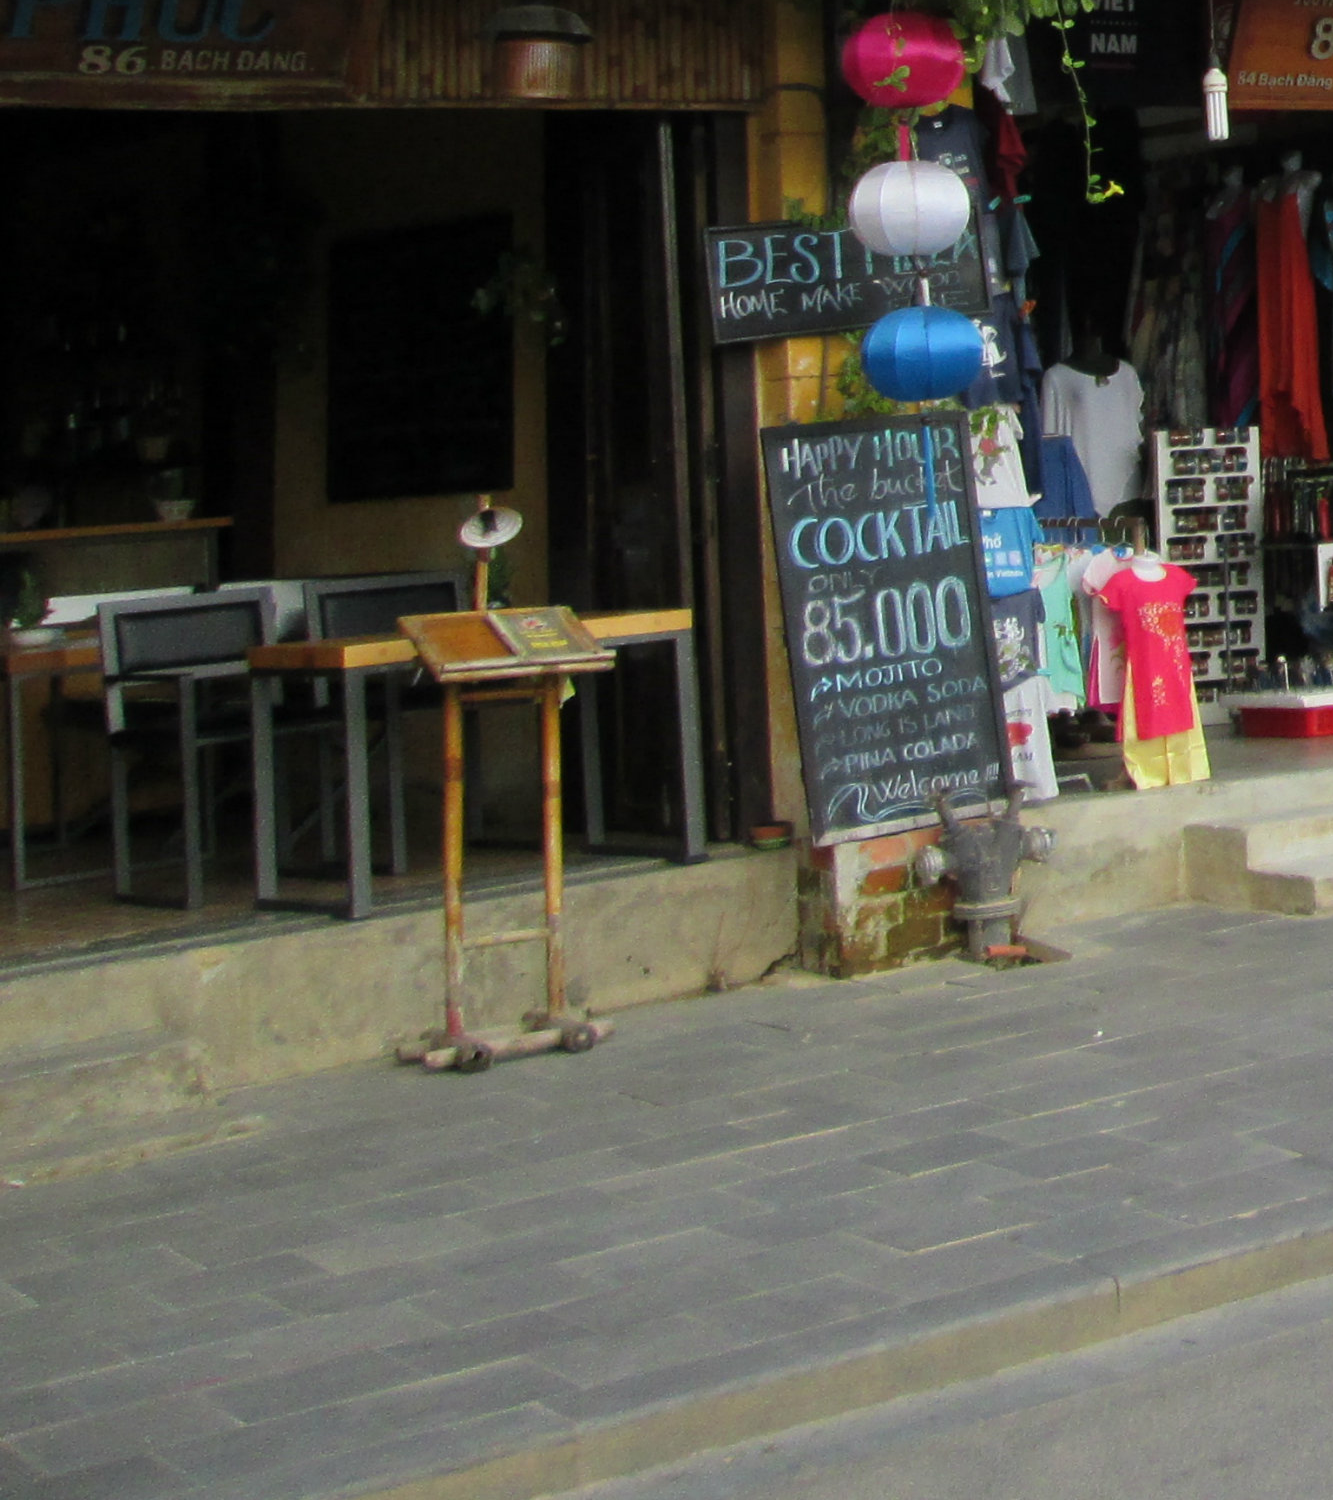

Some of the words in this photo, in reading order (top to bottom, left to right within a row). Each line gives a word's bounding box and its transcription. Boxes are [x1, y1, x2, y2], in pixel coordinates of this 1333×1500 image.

[162, 50, 233, 72] BACH
[1090, 33, 1138, 54] NAM
[1237, 71, 1257, 85] 84
[718, 228, 853, 289] BEST
[720, 287, 789, 320] HOME
[802, 281, 867, 313] MAKE
[781, 434, 863, 480] HAPPY
[873, 426, 960, 468] HOUR
[786, 472, 859, 515] The
[870, 459, 964, 501] buct
[787, 500, 971, 569] COCKTAIL
[808, 566, 881, 593] ONLY
[803, 576, 971, 668] 85.000
[835, 657, 943, 692] MOJITO
[837, 687, 919, 718] VODKA
[926, 676, 988, 703] SODA
[839, 721, 892, 748] LONG
[902, 731, 978, 762] COLADA
[870, 768, 981, 803] Welcome
